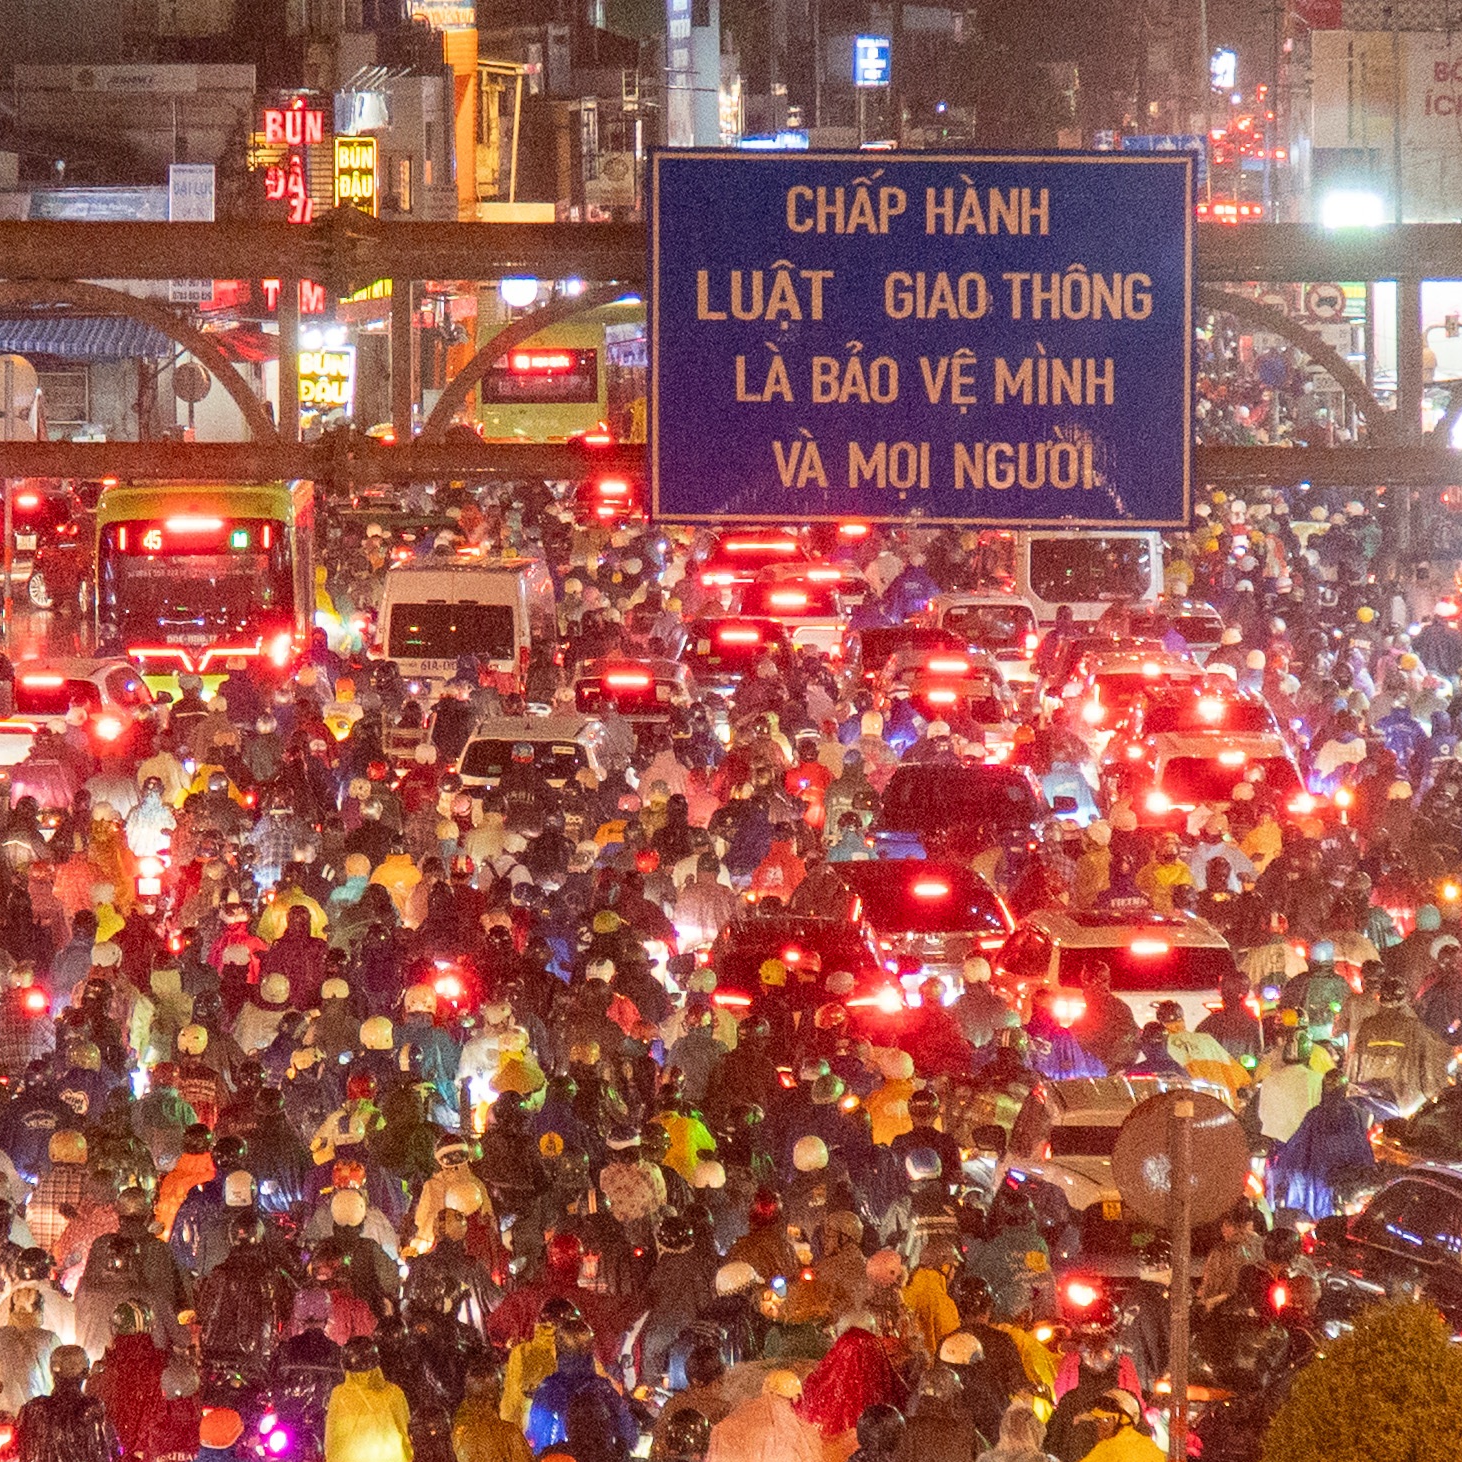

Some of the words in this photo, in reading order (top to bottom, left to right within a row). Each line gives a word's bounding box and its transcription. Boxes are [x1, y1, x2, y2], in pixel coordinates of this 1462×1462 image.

[265, 96, 323, 145] BÚN
[338, 142, 373, 169] BÚN
[786, 168, 907, 235] CHẤP
[925, 174, 1050, 235] HÀNH
[696, 259, 834, 330] LUẬT
[884, 271, 989, 321] GIAO
[1004, 263, 1153, 321] THÔNG
[735, 342, 794, 403] LÀ
[812, 341, 899, 404] BẢO
[920, 348, 977, 414] VỆ
[994, 343, 1115, 405] MÌNH
[772, 427, 827, 489] VÀ
[849, 442, 930, 500] MỌI
[954, 426, 1098, 491] NGƯỜI
